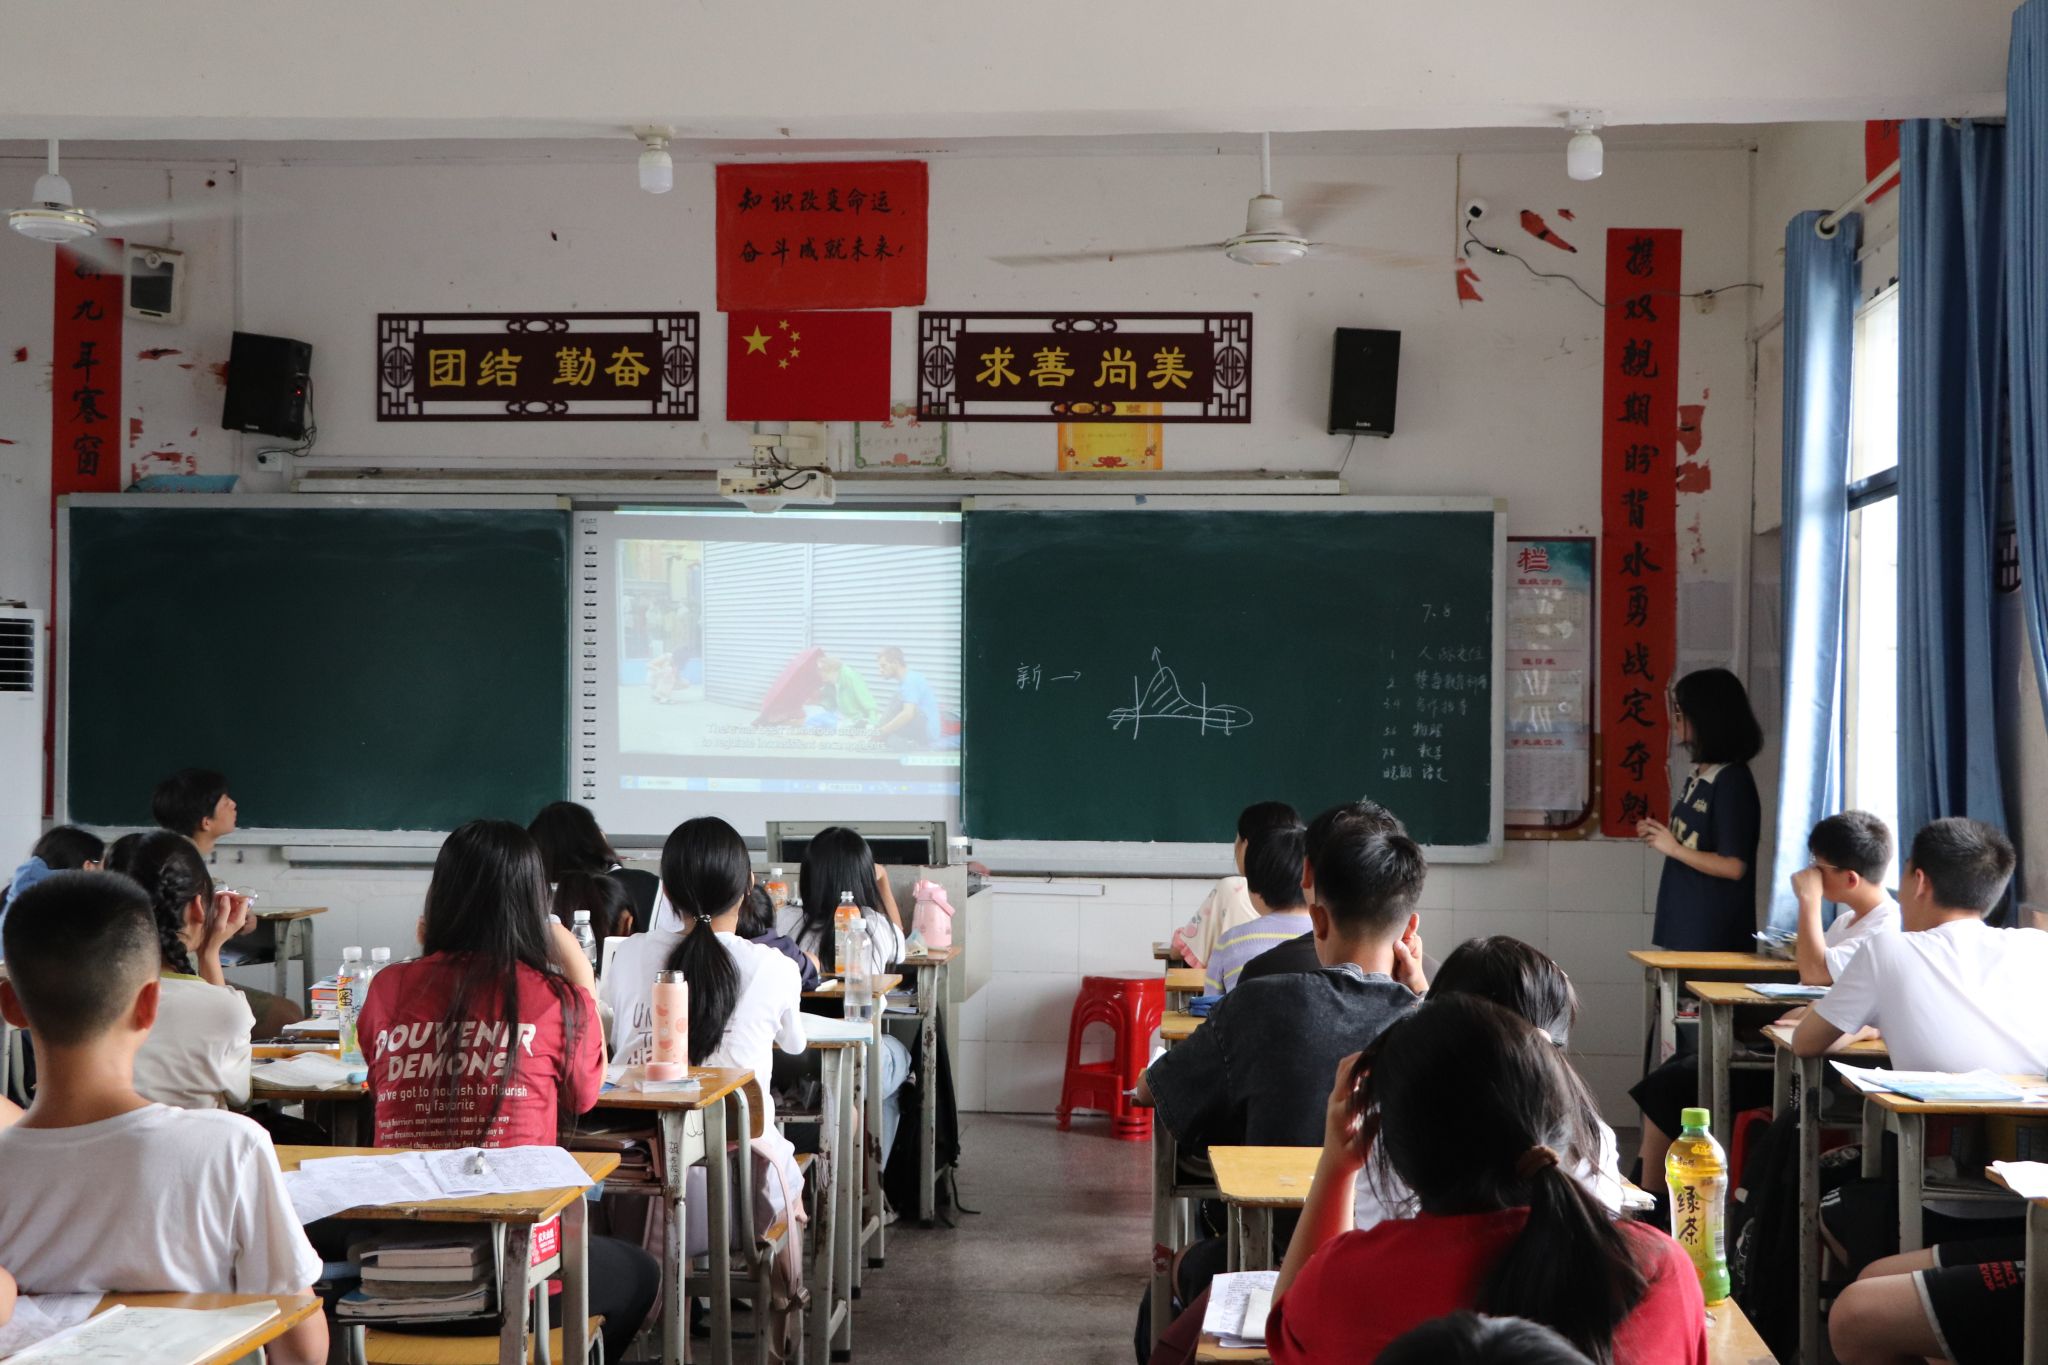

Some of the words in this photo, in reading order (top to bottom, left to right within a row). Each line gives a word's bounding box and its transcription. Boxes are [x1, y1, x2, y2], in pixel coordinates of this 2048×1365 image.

[428, 346, 651, 387] 团结勤奋
[975, 346, 1194, 390] 求善尚美
[1516, 547, 1551, 574] 栏
[1016, 662, 1042, 691] 新
[387, 1051, 510, 1082] DEMONS
[377, 1088, 397, 1103] ou've
[400, 1085, 417, 1100] got
[419, 1085, 429, 1098] to
[477, 1084, 487, 1096] to
[415, 1102, 431, 1114] my
[461, 1115, 477, 1123] stand
[498, 1116, 510, 1124] way
[476, 1127, 497, 1137] deiny
[1676, 1185, 1700, 1245] 绿茶
